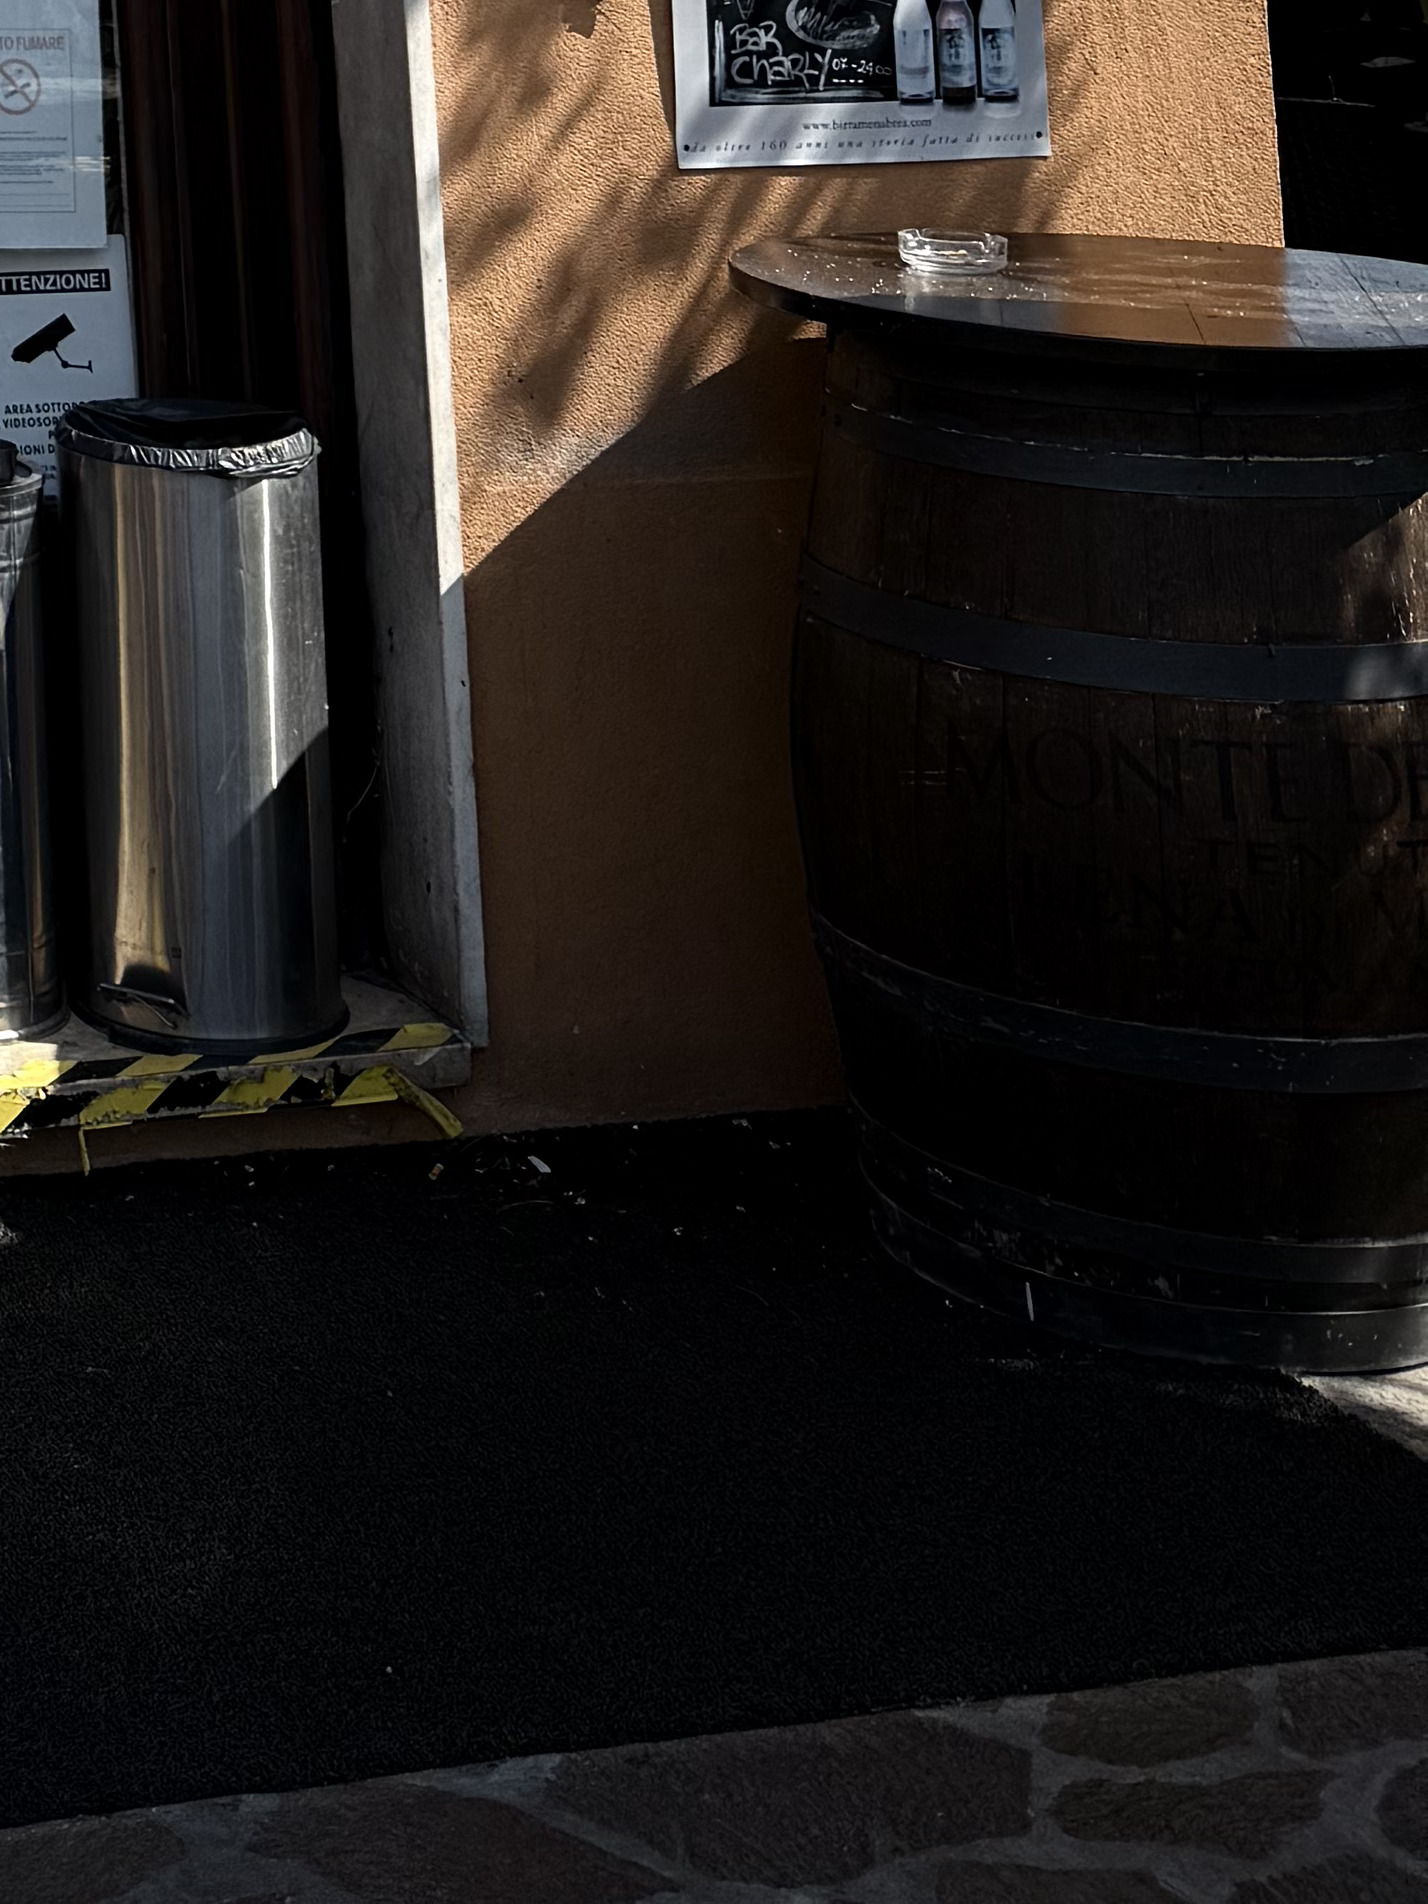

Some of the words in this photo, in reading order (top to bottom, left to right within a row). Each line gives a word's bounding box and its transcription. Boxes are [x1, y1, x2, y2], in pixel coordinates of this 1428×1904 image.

[16, 35, 66, 51] FUMARE
[761, 139, 787, 151] 160
[4, 403, 33, 415] AREA
